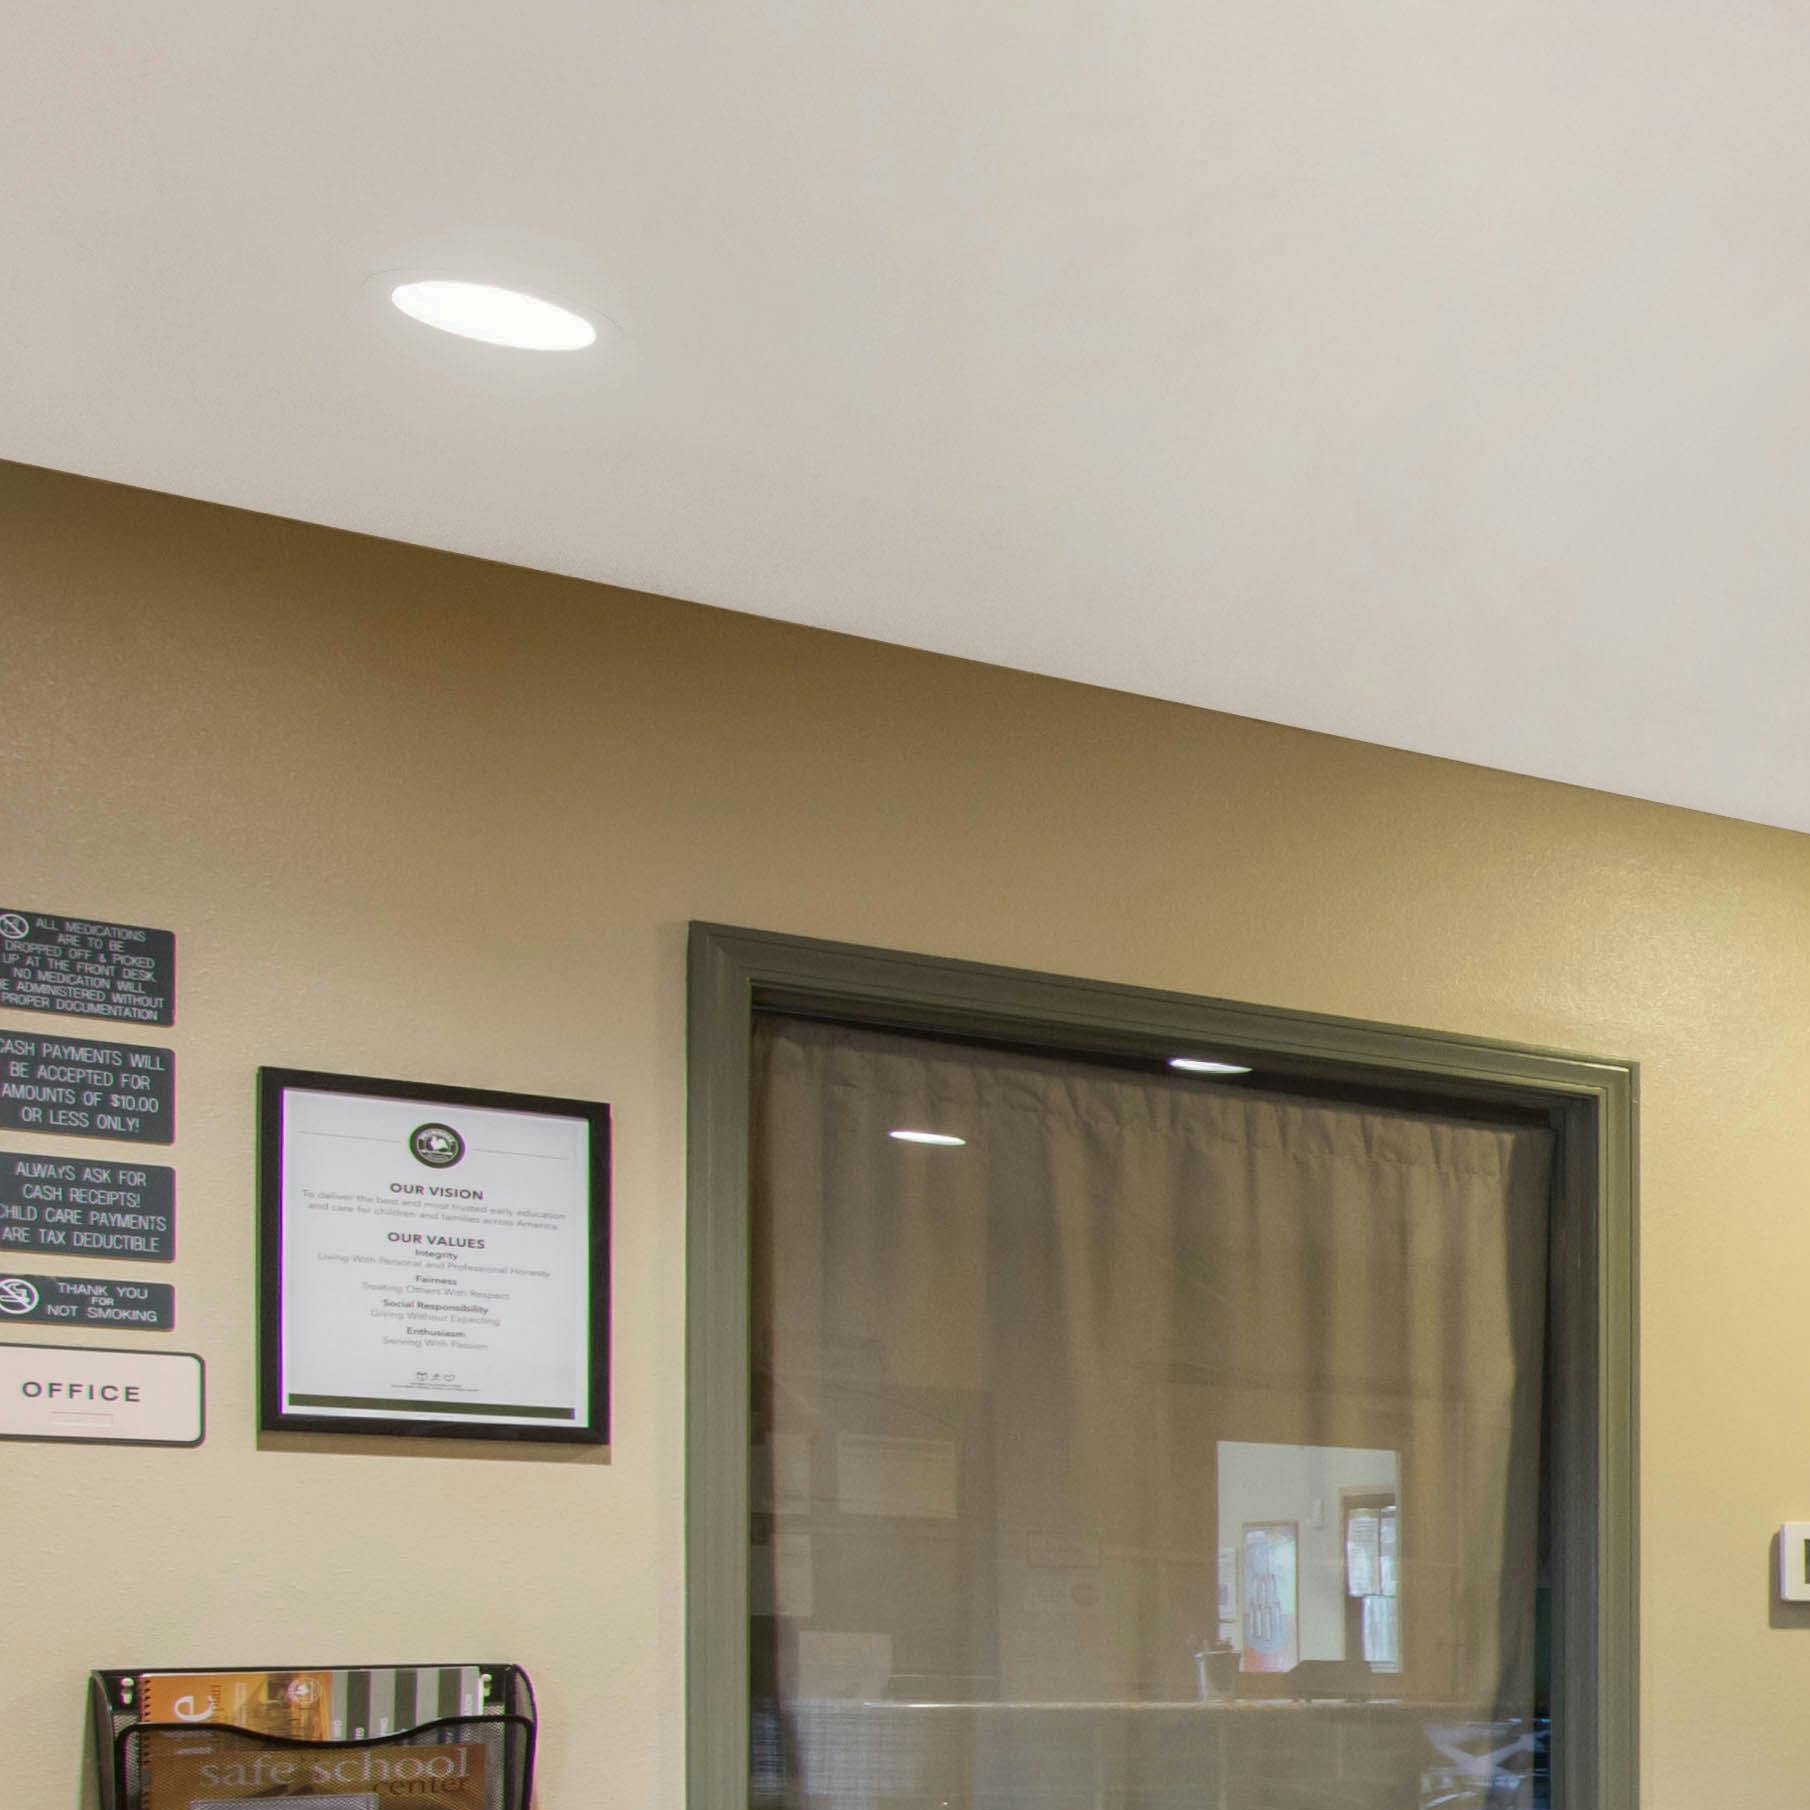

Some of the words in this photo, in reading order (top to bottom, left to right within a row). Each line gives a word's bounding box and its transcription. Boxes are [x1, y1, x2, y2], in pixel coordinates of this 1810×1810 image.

[36, 918, 59, 931] ALL
[65, 922, 146, 942] MEDICATIONS
[57, 933, 82, 946] ARE
[87, 937, 103, 949] TO
[109, 940, 124, 952] BE
[4, 941, 62, 958] DROPPED
[69, 949, 92, 961] OFF
[112, 954, 156, 969] PICKED
[2, 952, 20, 964] UP
[26, 957, 41, 968] AT
[47, 958, 70, 972] THE
[76, 961, 116, 977] FRONT
[122, 967, 157, 983] DESK
[13, 967, 32, 980] NO
[38, 970, 111, 990] MEDICATION
[117, 981, 146, 994] WILL
[1, 991, 50, 1009] PROPER
[56, 998, 159, 1021] DOCUMENTATION
[16, 981, 106, 1002] ADMINISTERED
[112, 993, 165, 1009] WITHOUT
[42, 1043, 123, 1066] PAYMENTS
[129, 1053, 166, 1071] WILL
[9, 1061, 30, 1078] BE
[36, 1065, 114, 1087] ACCEPTED
[120, 1073, 151, 1090] FOR
[1, 1083, 76, 1104] AMOUNTS
[82, 1091, 103, 1107] OF
[111, 1094, 160, 1113] $10.00
[21, 1107, 43, 1123] OR
[49, 1110, 90, 1128] LESS
[96, 1114, 140, 1133] ONLY!
[15, 1161, 76, 1181] ALWAYS
[82, 1167, 112, 1184] ASK
[119, 1170, 147, 1187] FOR
[22, 1184, 63, 1201] CASH
[69, 1188, 141, 1209] RECEIPTS!
[390, 1182, 425, 1196] OUR
[429, 1186, 484, 1200] VISION
[308, 1202, 329, 1210] and
[374, 1207, 416, 1217] children
[420, 1210, 439, 1219] and
[356, 1193, 373, 1202] the
[402, 1199, 421, 1208] and
[516, 1209, 566, 1220] education
[44, 1208, 83, 1225] CARE
[89, 1211, 168, 1232] PAYMENTS
[2, 1226, 32, 1244] ARE
[38, 1228, 66, 1245] TAX
[73, 1231, 161, 1253] DEDUCTIBLE
[387, 1231, 422, 1245] OUR
[427, 1234, 485, 1250] VALUES
[415, 1248, 458, 1260] Integrity
[447, 1262, 508, 1274] Professional
[56, 1282, 109, 1297] THANK
[115, 1286, 149, 1300] YOU
[415, 1275, 457, 1286] Fairness
[47, 1304, 79, 1318] NOT
[86, 1306, 158, 1323] SMOKING
[91, 1296, 115, 1307] FOR
[382, 1299, 415, 1309] Social
[417, 1300, 488, 1315] Responsibility
[406, 1327, 465, 1338] Enthusiasm
[22, 1381, 142, 1403] OFFICE
[201, 1755, 298, 1786] safe
[311, 1748, 471, 1784] school
[374, 1777, 468, 1796] center
